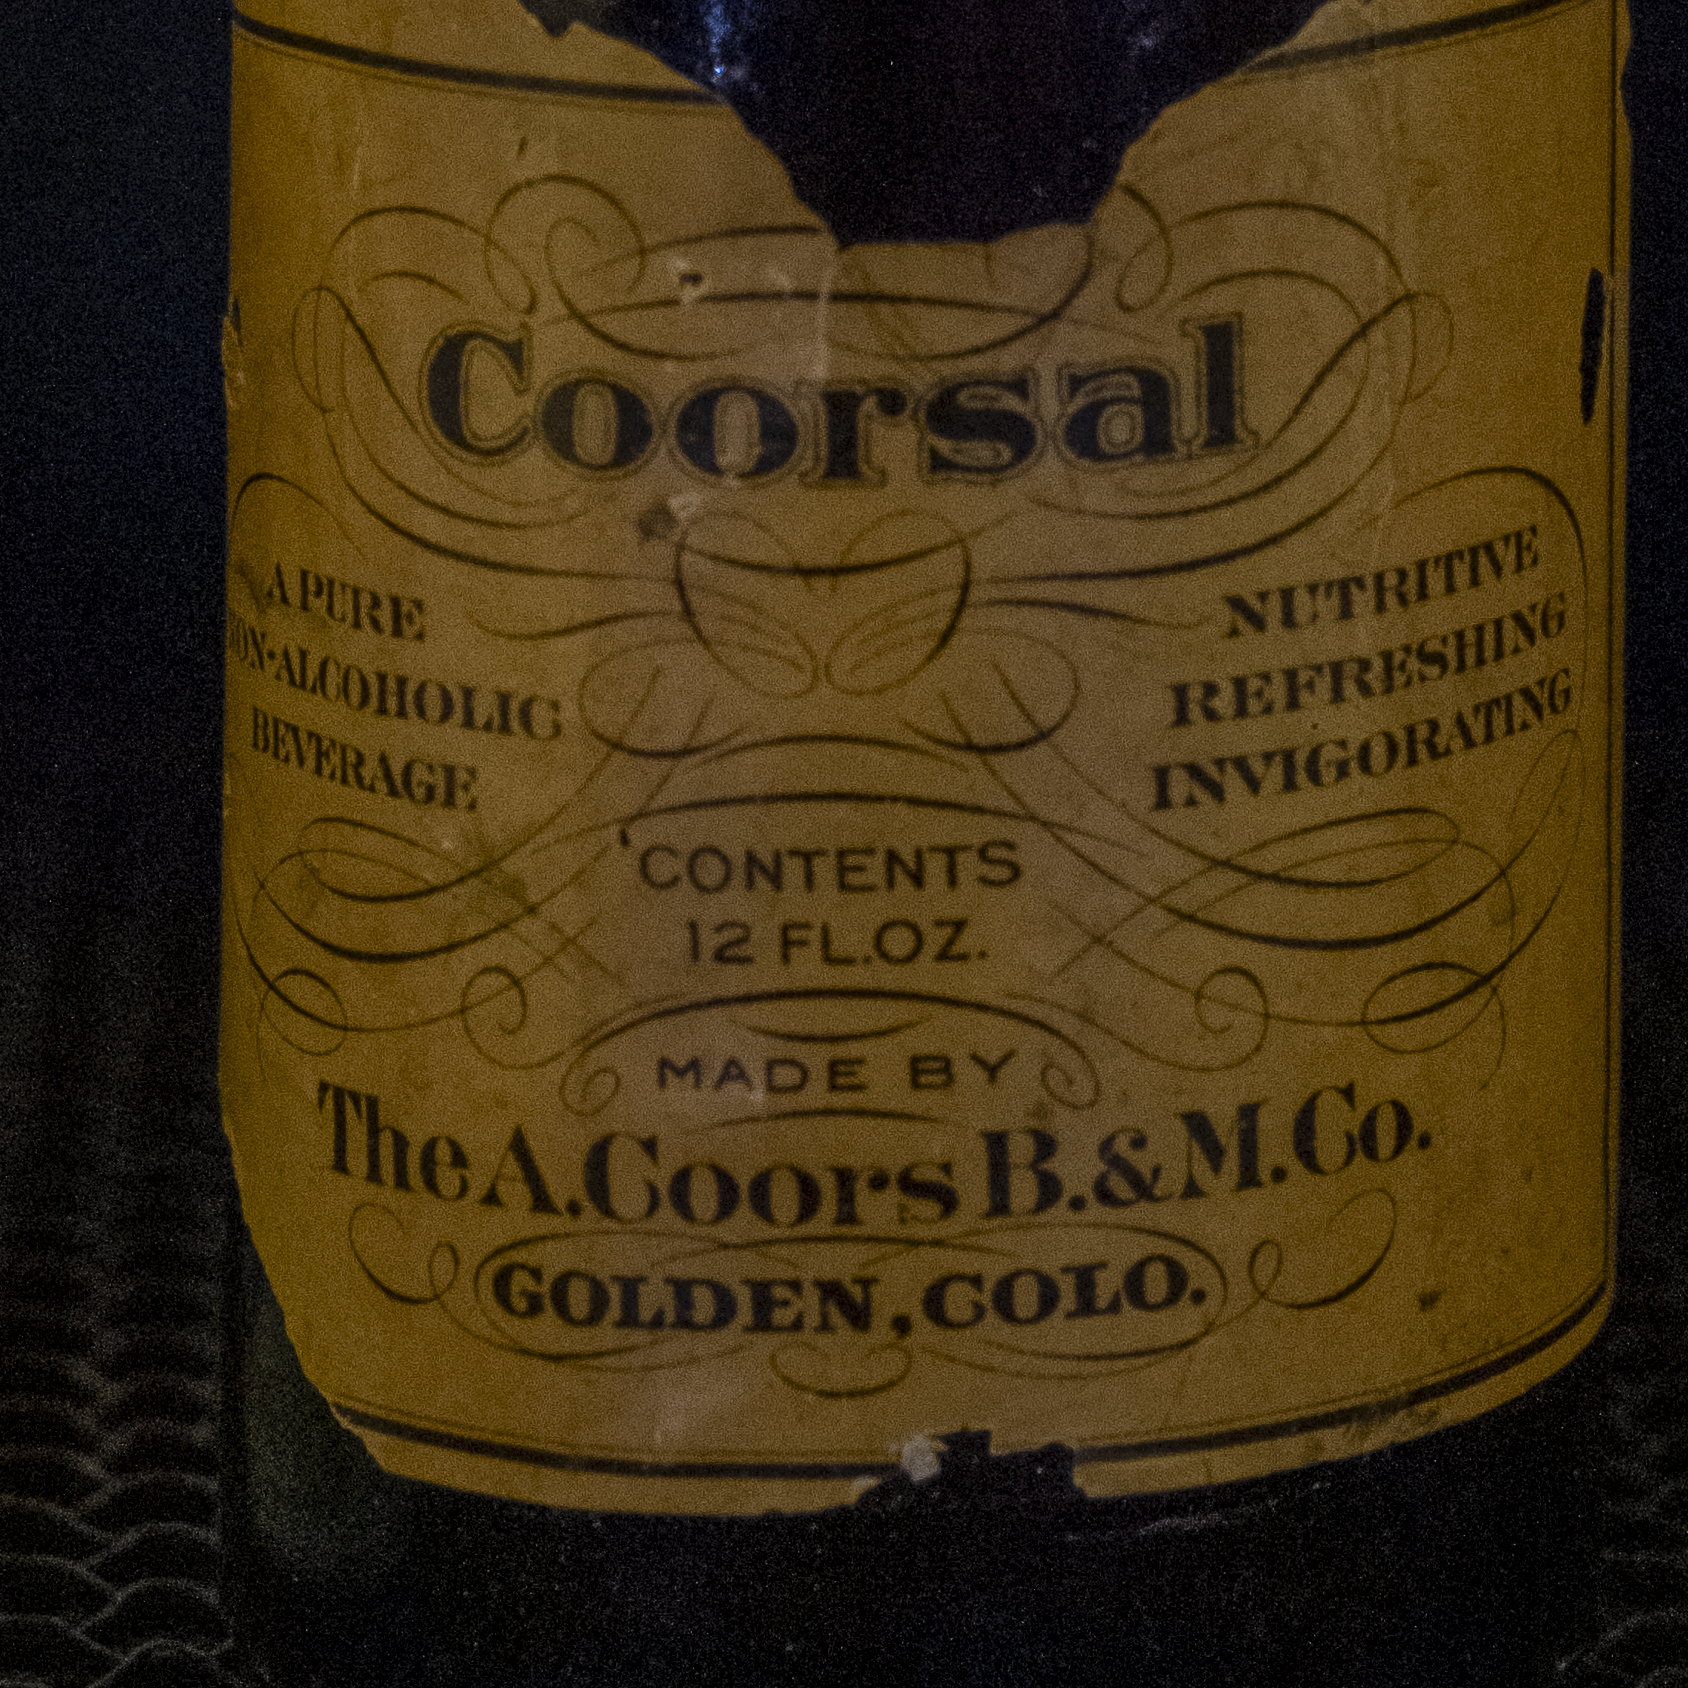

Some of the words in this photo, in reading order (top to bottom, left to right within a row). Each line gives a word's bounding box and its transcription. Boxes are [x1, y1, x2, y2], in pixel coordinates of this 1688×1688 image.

[418, 310, 1262, 488] Coorsal
[265, 560, 292, 608] A
[300, 567, 426, 644] PURE
[1222, 524, 1540, 640] NUTRITIVE
[1168, 590, 1568, 727] REFRESHING
[251, 704, 479, 814] BEVERAGE
[1150, 667, 1573, 812] INVIGORATING
[638, 840, 1022, 894] CONTENTS
[687, 919, 756, 966] 12
[656, 1054, 870, 1095] MADE
[909, 1048, 1018, 1090] BY
[317, 1078, 472, 1205] The
[921, 1251, 1208, 1330] COLO.
